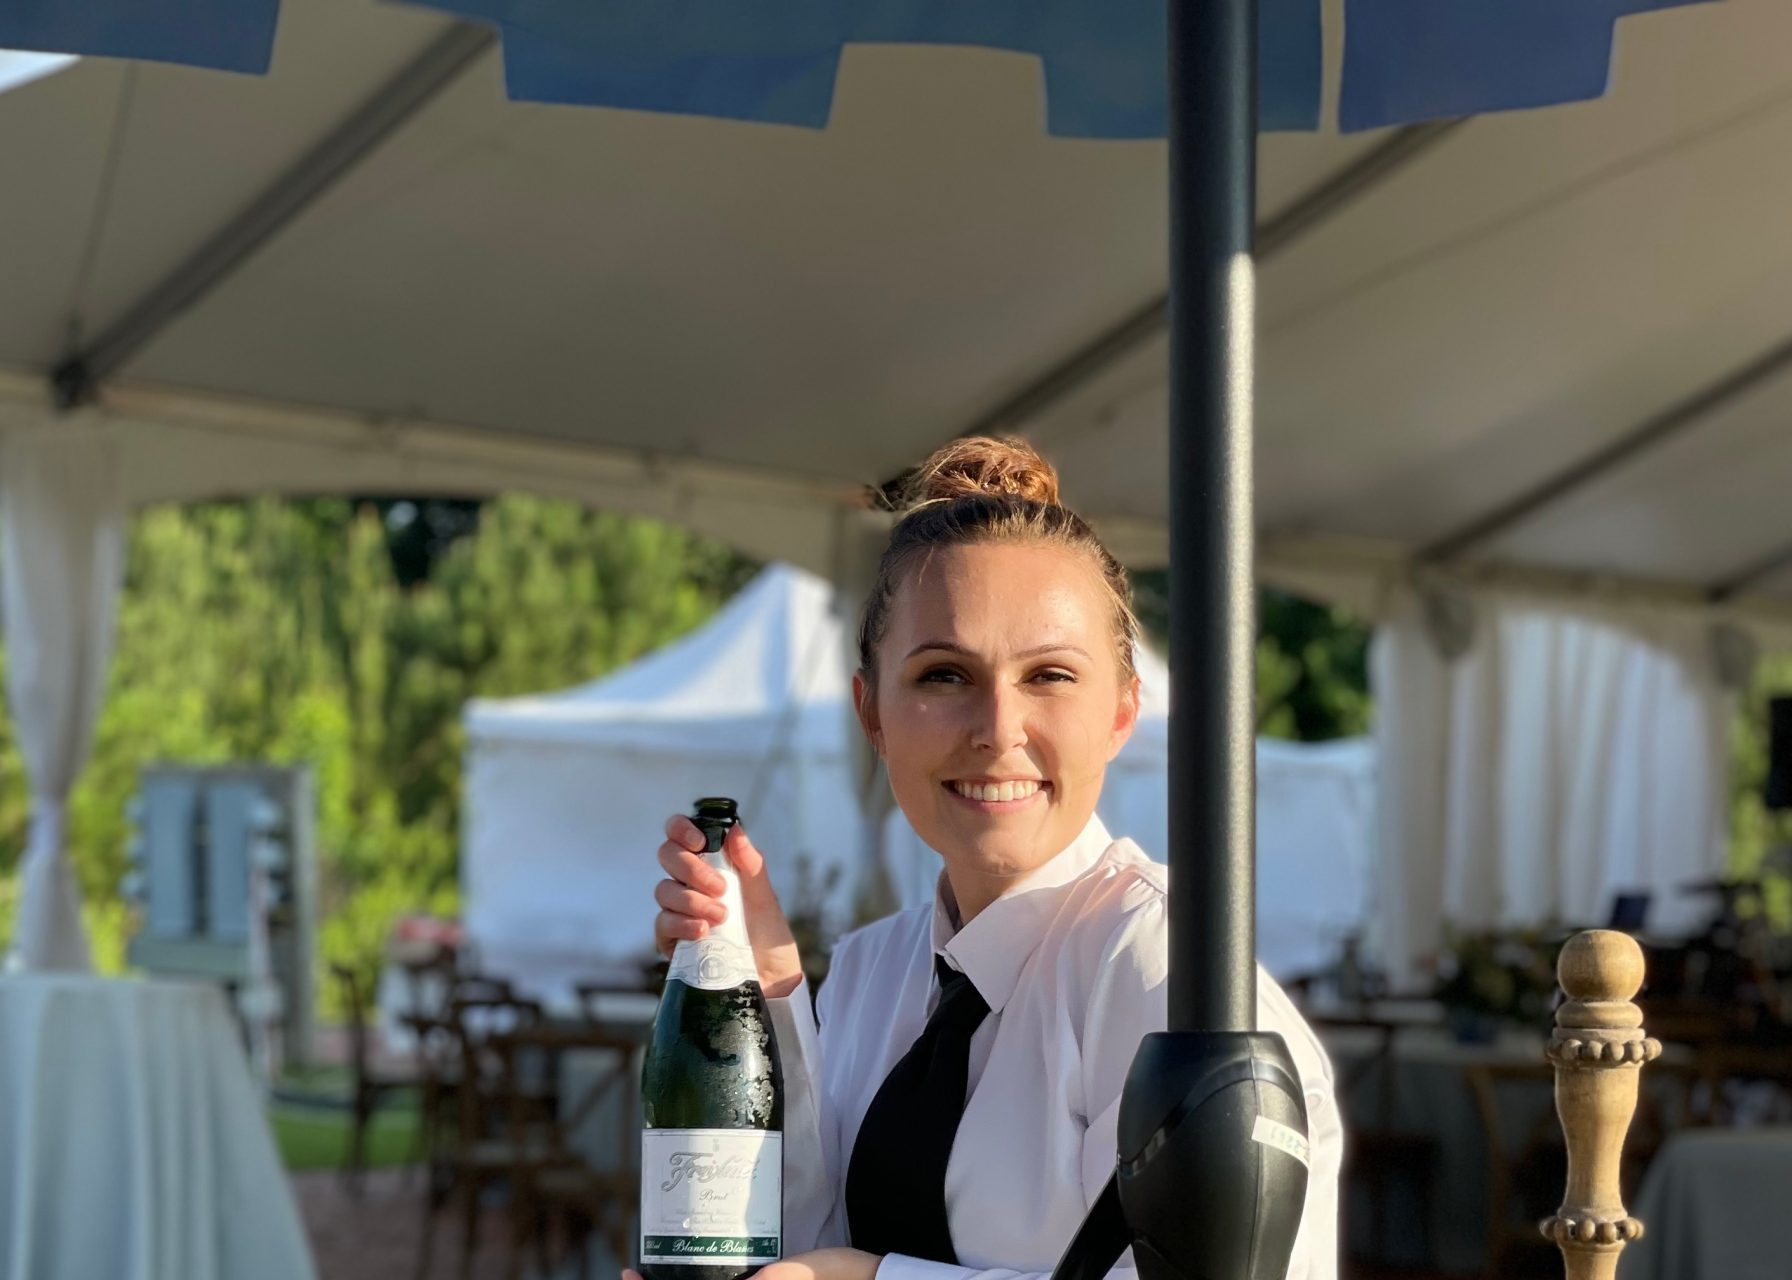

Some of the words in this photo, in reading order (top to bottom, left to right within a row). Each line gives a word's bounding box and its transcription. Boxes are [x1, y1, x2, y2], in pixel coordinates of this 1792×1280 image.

[702, 943, 725, 953] Brut
[699, 1189, 728, 1203] Brut
[672, 1239, 704, 1253] Blanc
[706, 1241, 718, 1253] de
[720, 1240, 754, 1253] Blancs
